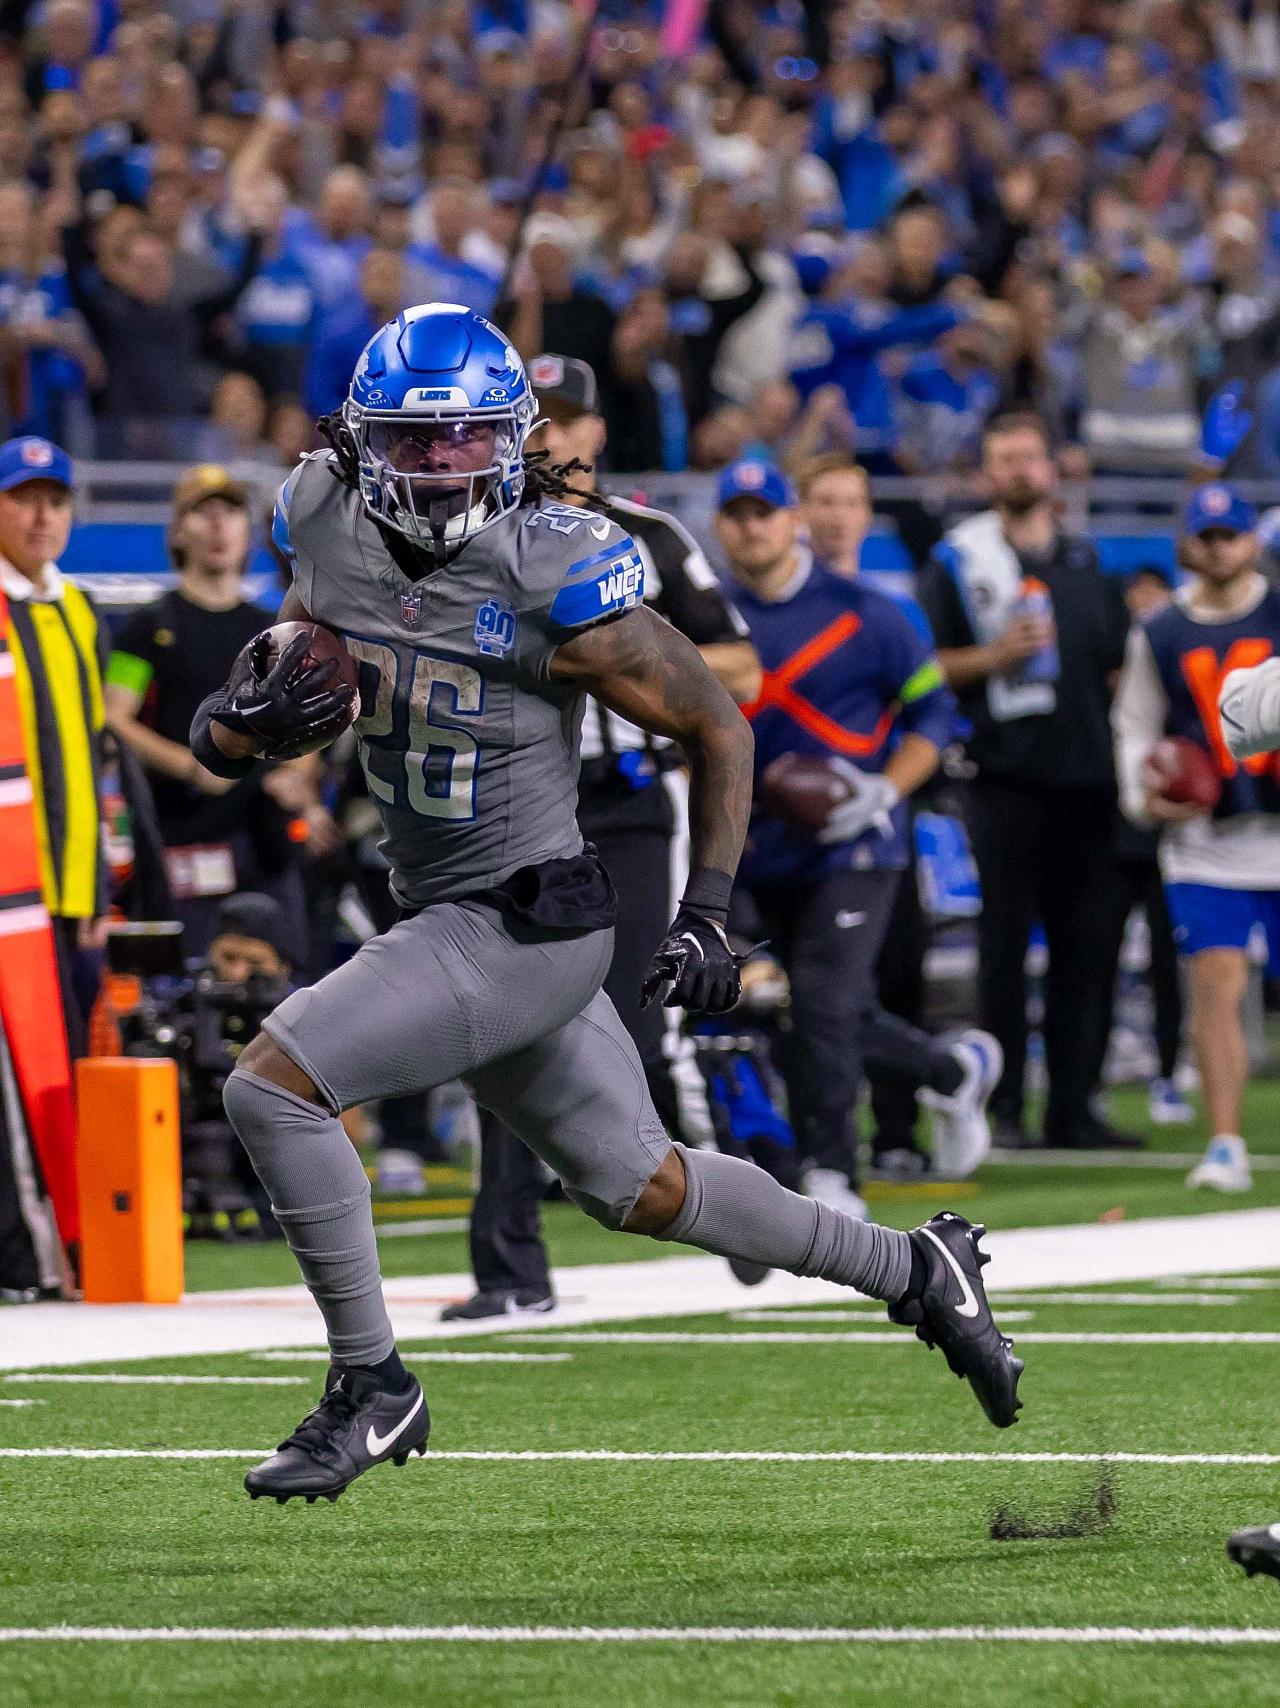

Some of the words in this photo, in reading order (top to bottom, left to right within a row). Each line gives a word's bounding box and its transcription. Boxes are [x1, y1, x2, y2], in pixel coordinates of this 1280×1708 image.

[525, 503, 599, 537] 26
[597, 562, 644, 606] WCF
[477, 604, 517, 645] 90
[343, 631, 486, 822] 26
